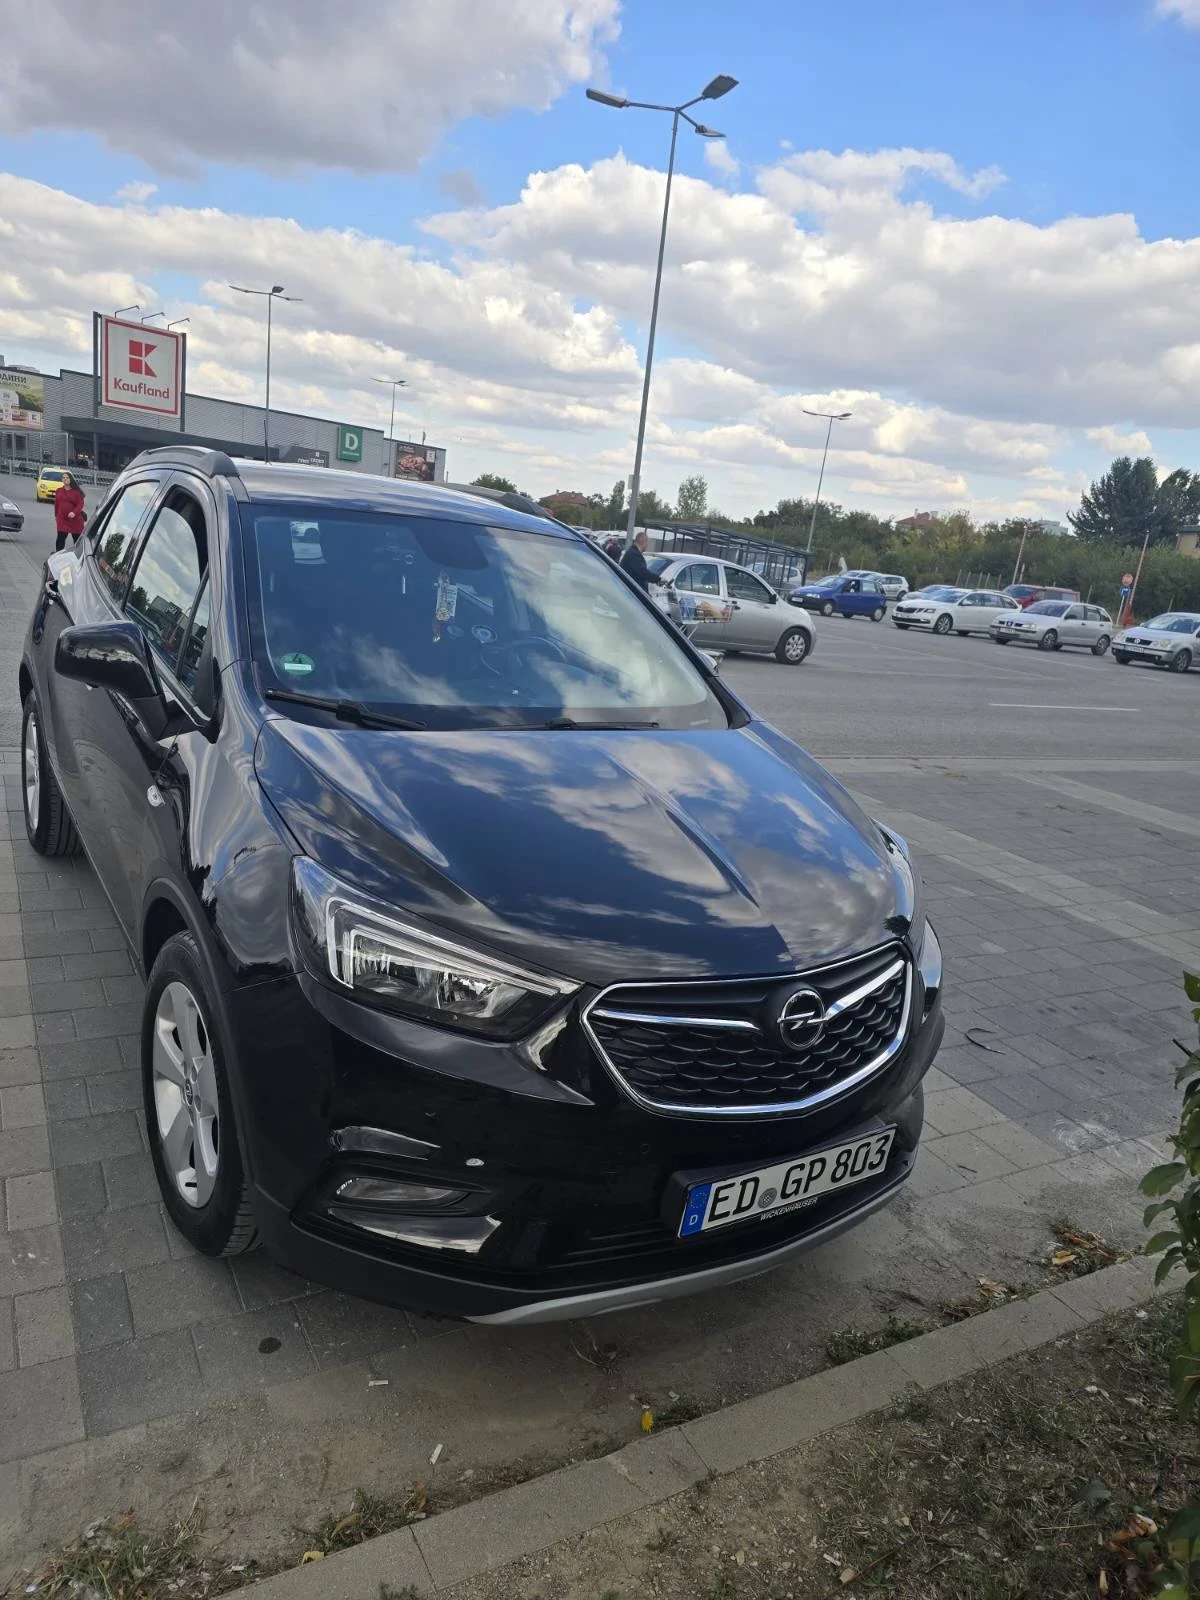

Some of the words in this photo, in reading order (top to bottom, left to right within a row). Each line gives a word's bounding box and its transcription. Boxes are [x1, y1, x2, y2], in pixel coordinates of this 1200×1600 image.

[129, 340, 157, 377] K
[113, 377, 170, 399] Kaufland
[345, 432, 358, 450] D
[708, 1176, 760, 1222] ED
[780, 1157, 827, 1199] GP
[830, 1134, 890, 1183] 803
[689, 1214, 698, 1226] D
